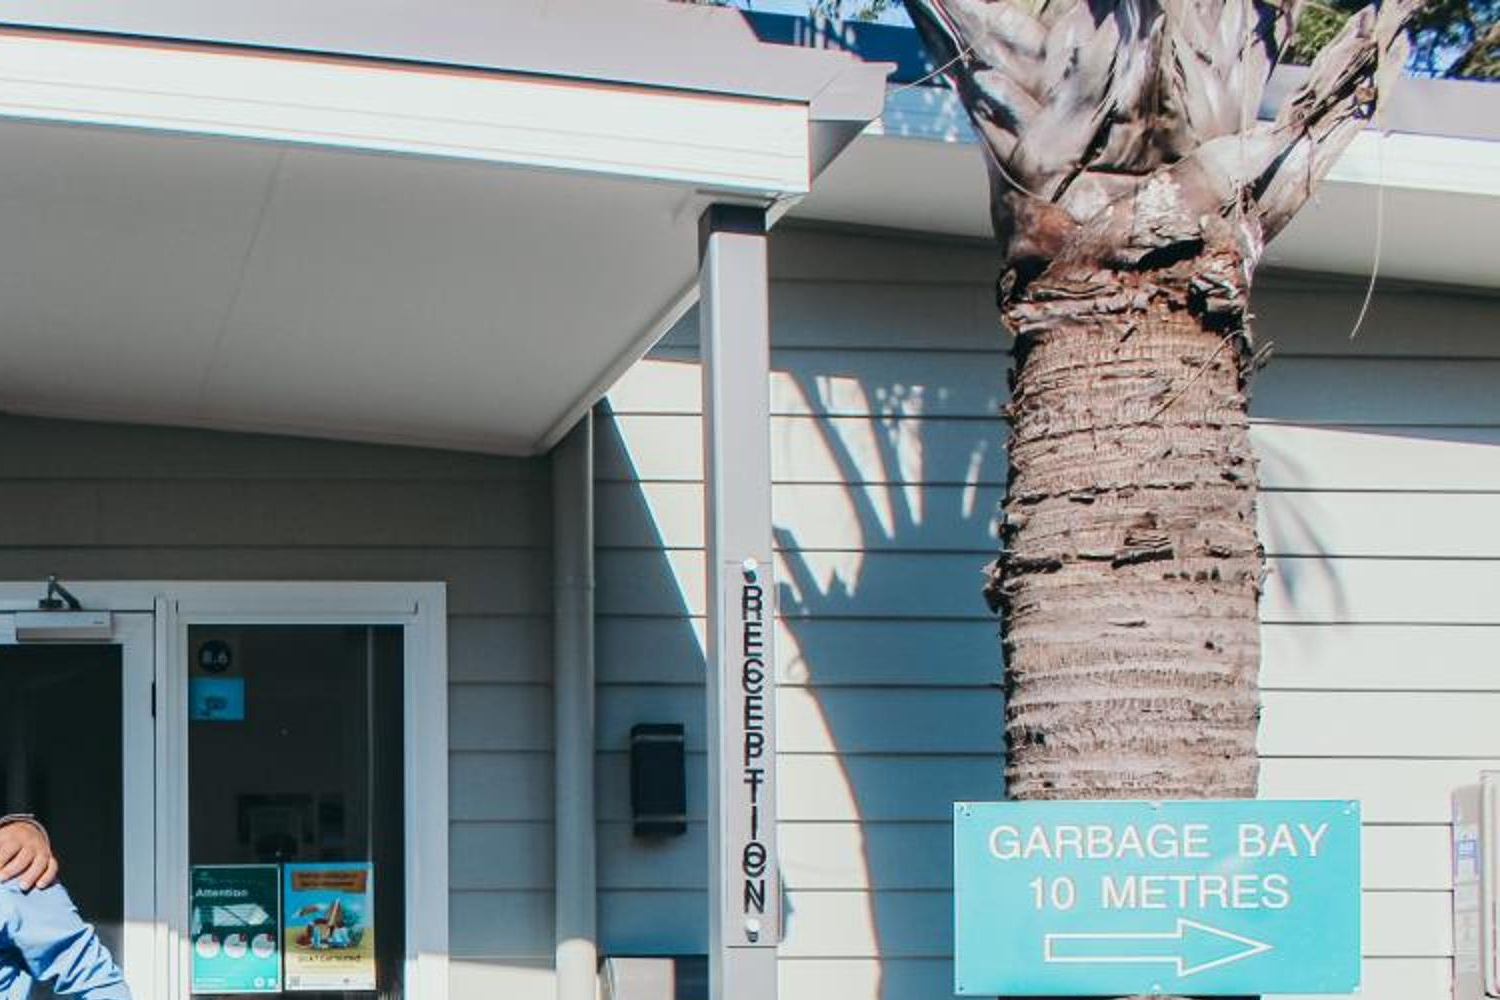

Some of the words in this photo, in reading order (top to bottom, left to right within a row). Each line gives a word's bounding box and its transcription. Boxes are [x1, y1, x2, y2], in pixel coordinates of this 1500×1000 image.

[741, 584, 766, 914] RECEPTION
[987, 824, 1210, 860] GARBAGE
[1237, 823, 1330, 858] BAY
[195, 887, 249, 897] Attention
[1030, 877, 1076, 911] 10
[1102, 875, 1291, 910] METRES
